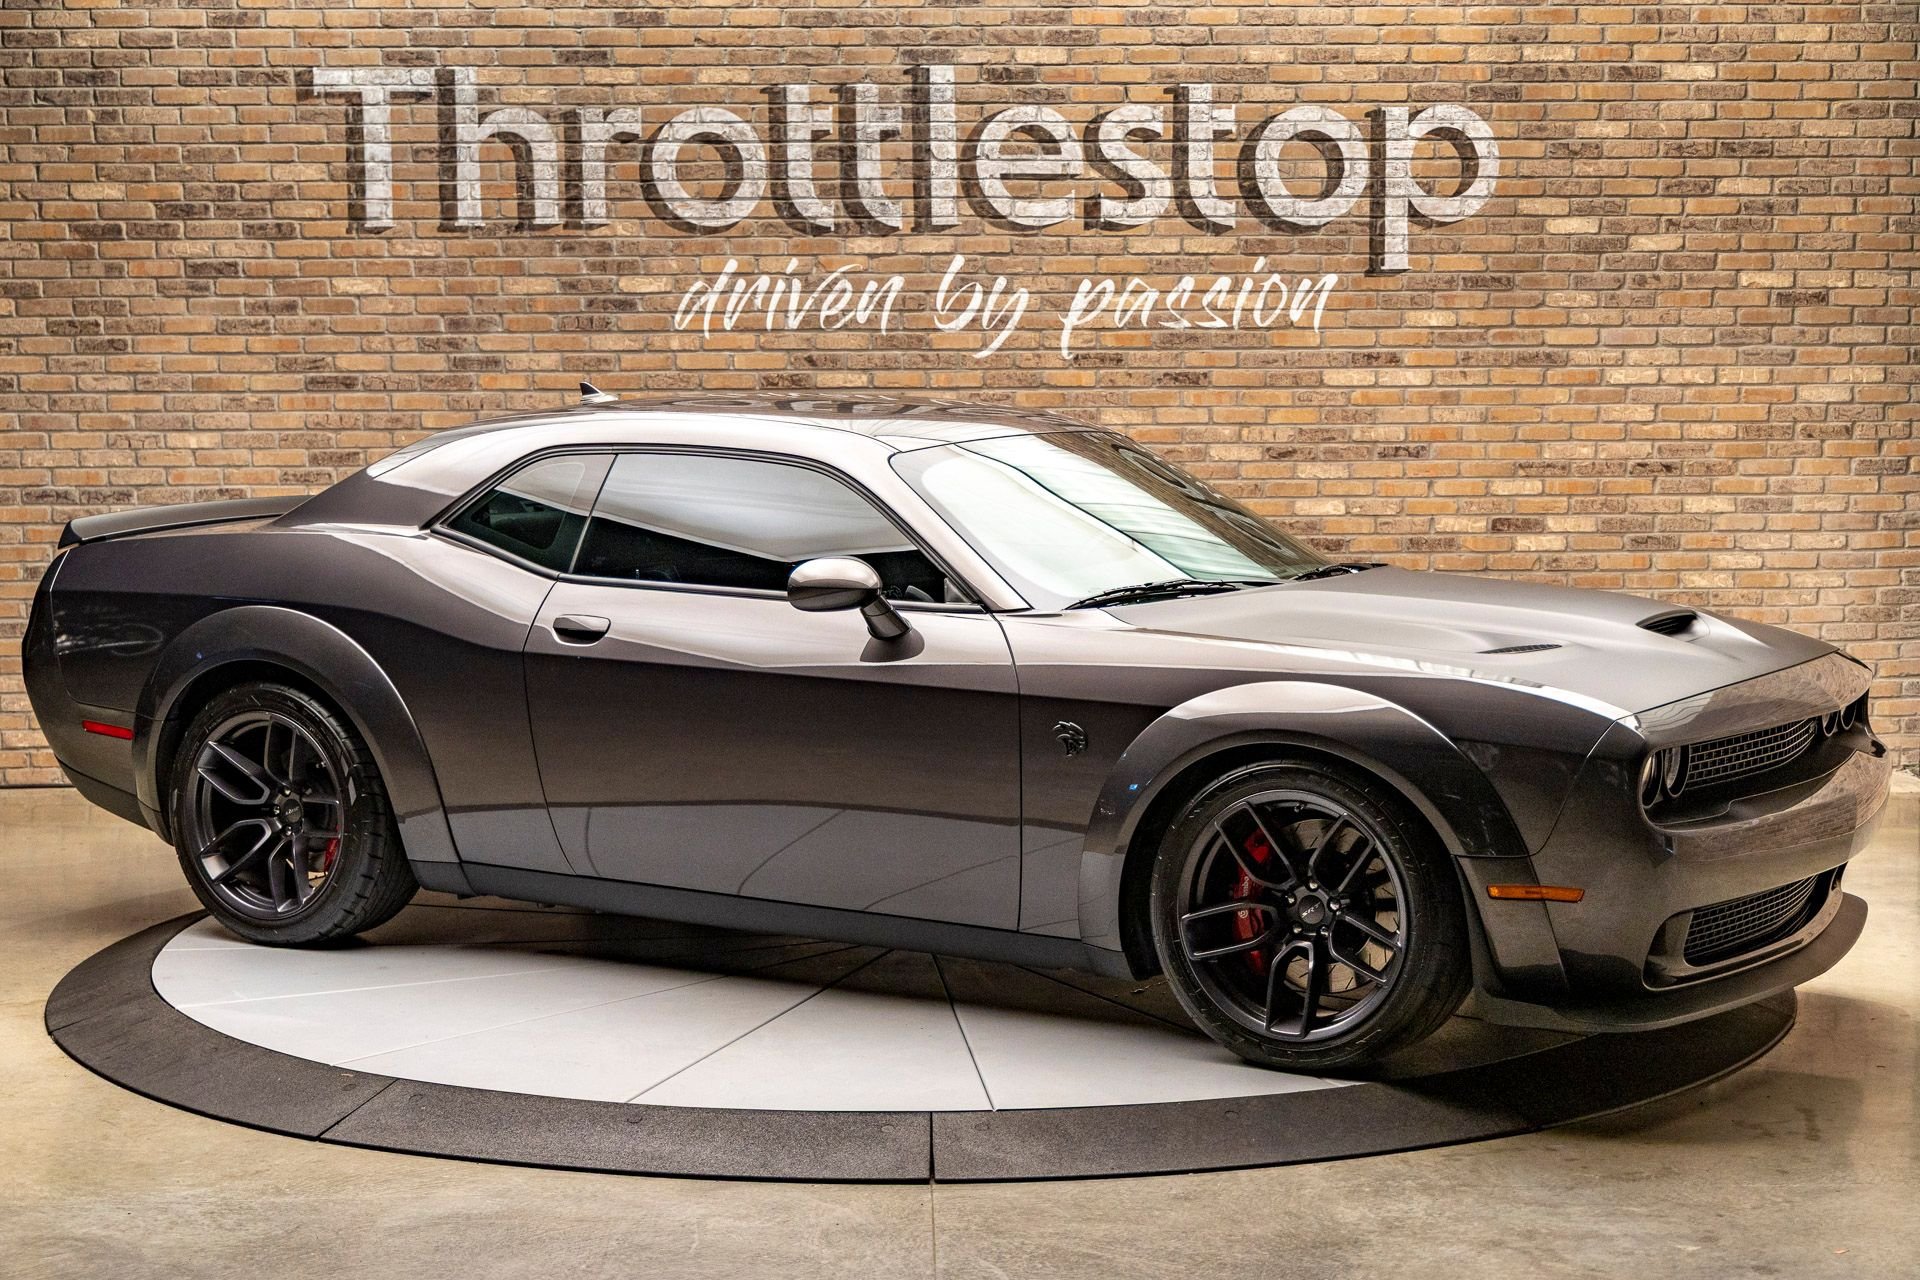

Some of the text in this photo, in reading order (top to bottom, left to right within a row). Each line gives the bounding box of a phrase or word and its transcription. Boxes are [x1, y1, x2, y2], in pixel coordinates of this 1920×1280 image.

[298, 63, 1501, 276] Throttlestop
[674, 255, 1338, 359] driven by passion
